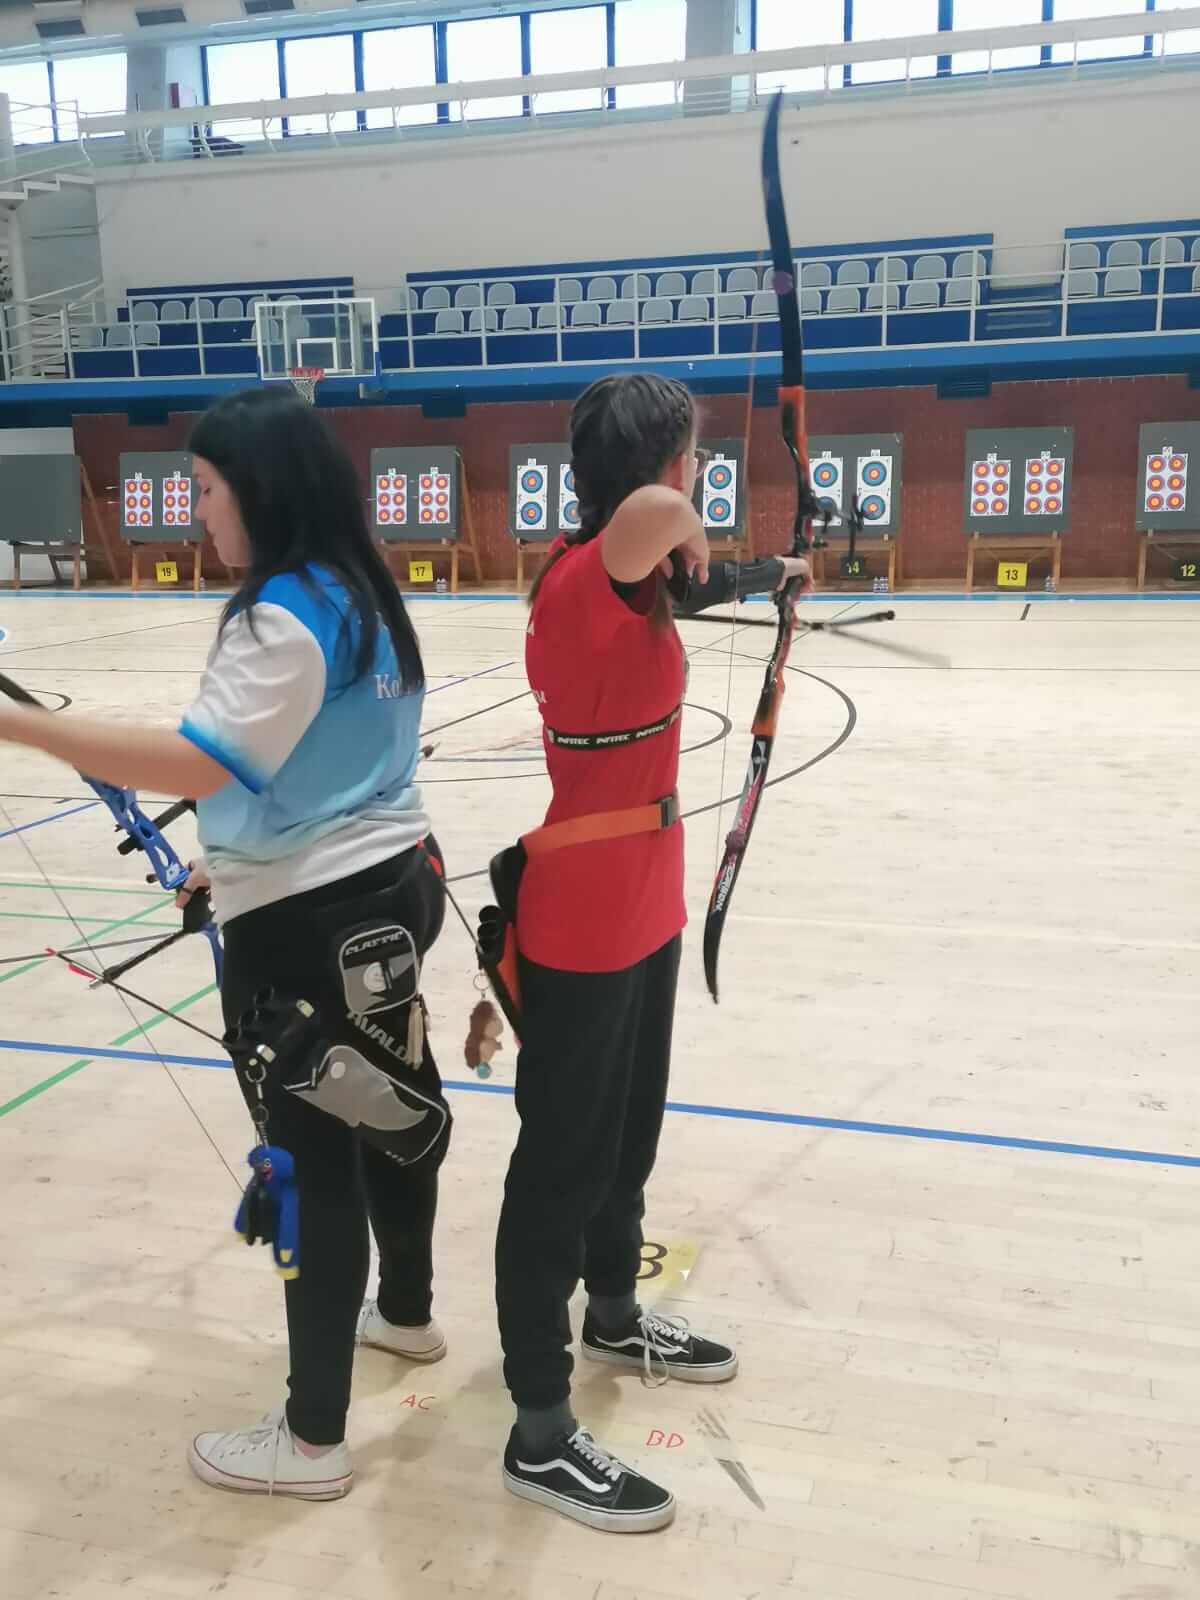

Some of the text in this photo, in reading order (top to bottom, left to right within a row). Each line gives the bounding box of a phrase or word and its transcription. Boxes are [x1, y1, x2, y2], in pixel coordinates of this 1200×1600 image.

[415, 566, 425, 577] 17
[1004, 568, 1019, 581] 13
[1180, 563, 1196, 577] 12
[399, 1393, 437, 1411] AC
[646, 1429, 685, 1449] BD
